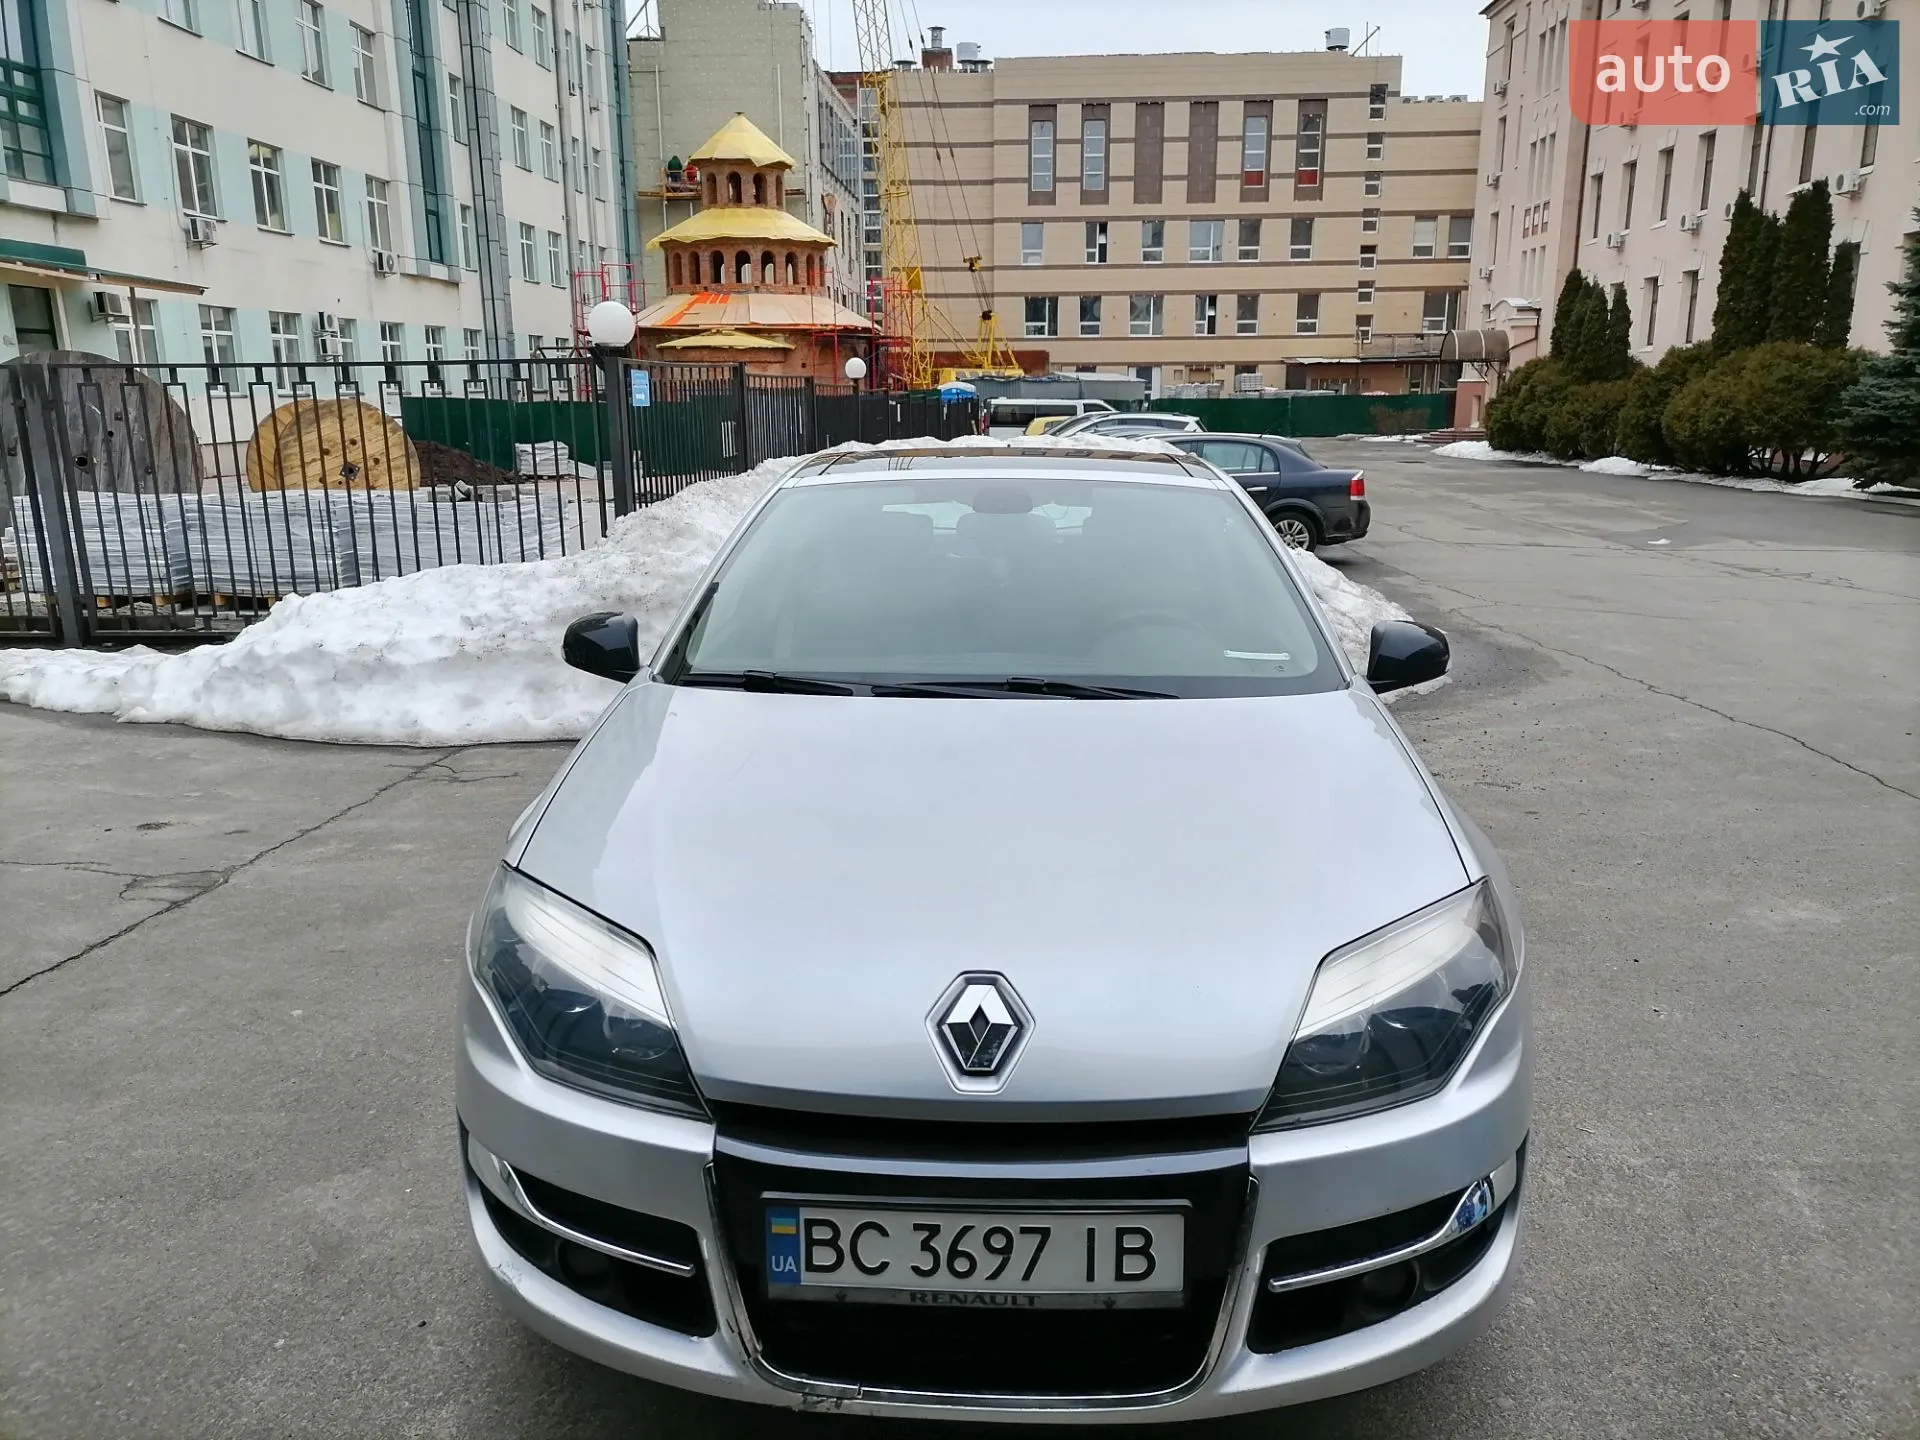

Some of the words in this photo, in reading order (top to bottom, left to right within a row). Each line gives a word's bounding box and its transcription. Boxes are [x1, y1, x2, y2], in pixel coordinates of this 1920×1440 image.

[803, 1217, 890, 1276] BC
[910, 1222, 1052, 1281] 3697
[1086, 1226, 1157, 1282] IB
[771, 1255, 798, 1273] UA
[908, 1292, 1041, 1307] RENAULT
